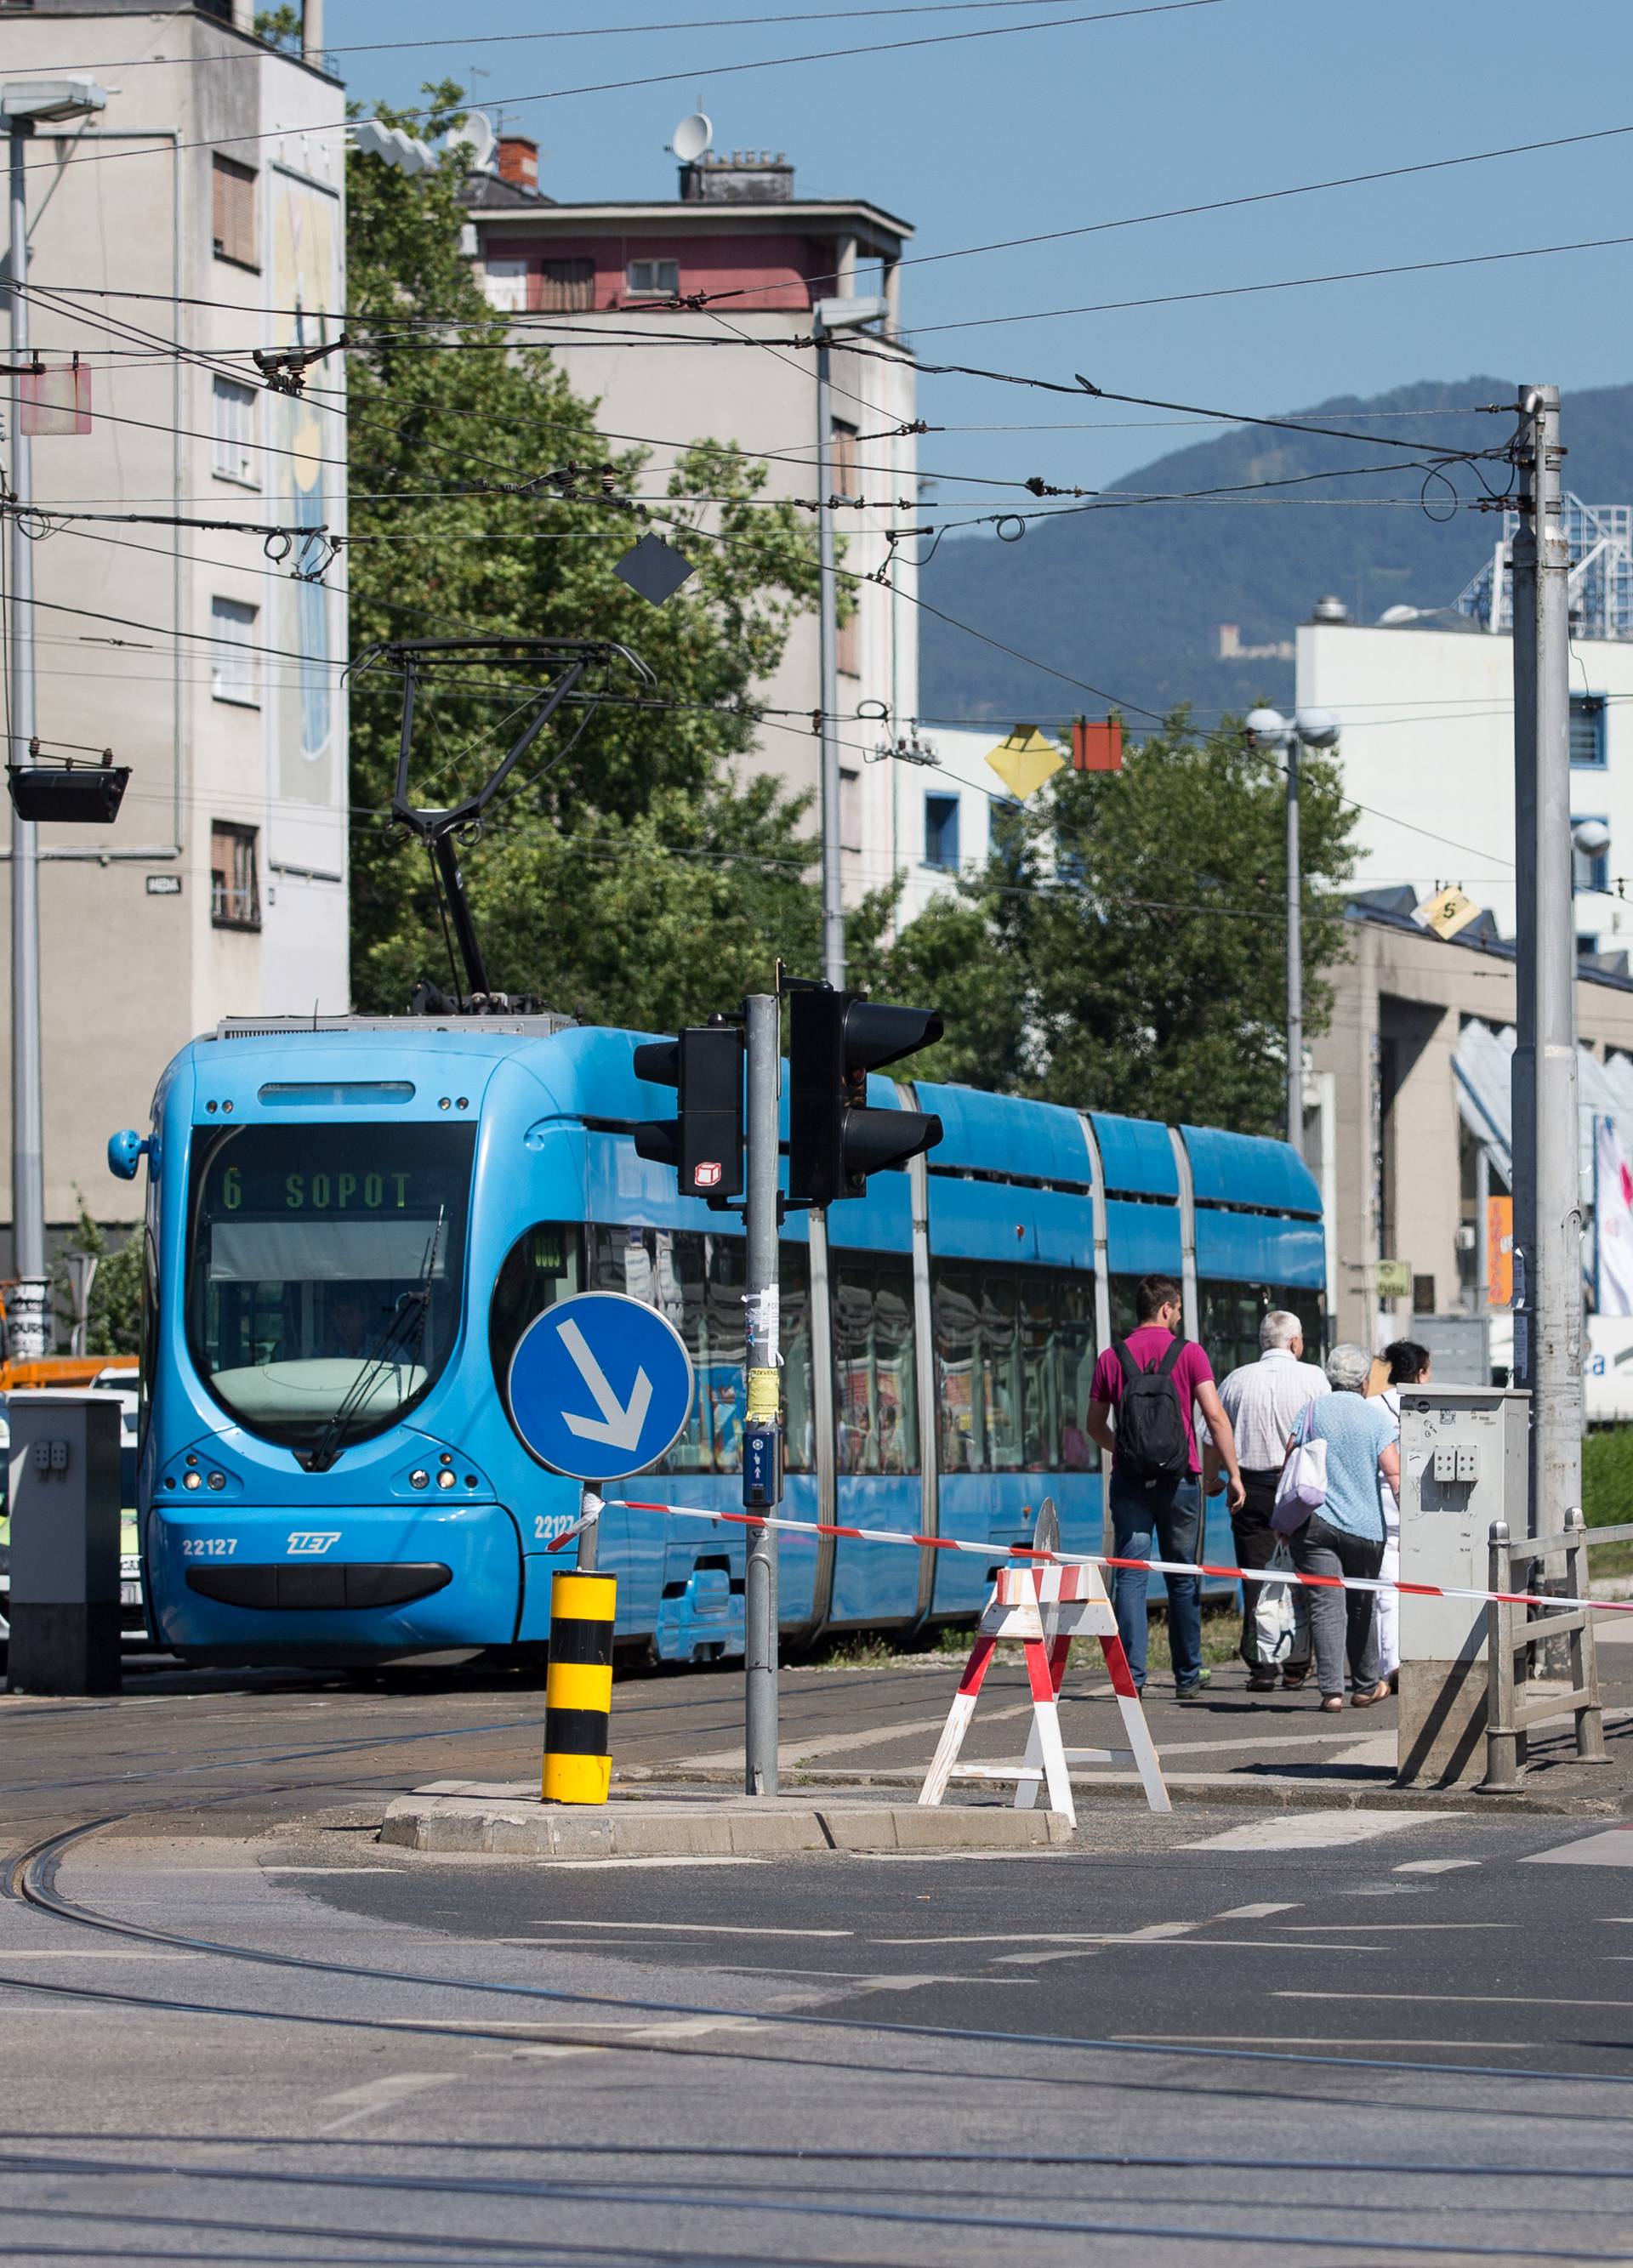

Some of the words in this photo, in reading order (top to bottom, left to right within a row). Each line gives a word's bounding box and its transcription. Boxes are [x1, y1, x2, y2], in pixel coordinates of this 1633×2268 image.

[224, 1167, 242, 1209] 6
[286, 1173, 411, 1208] SOPOT
[183, 1538, 237, 1555] 22127
[287, 1532, 342, 1554] ZET
